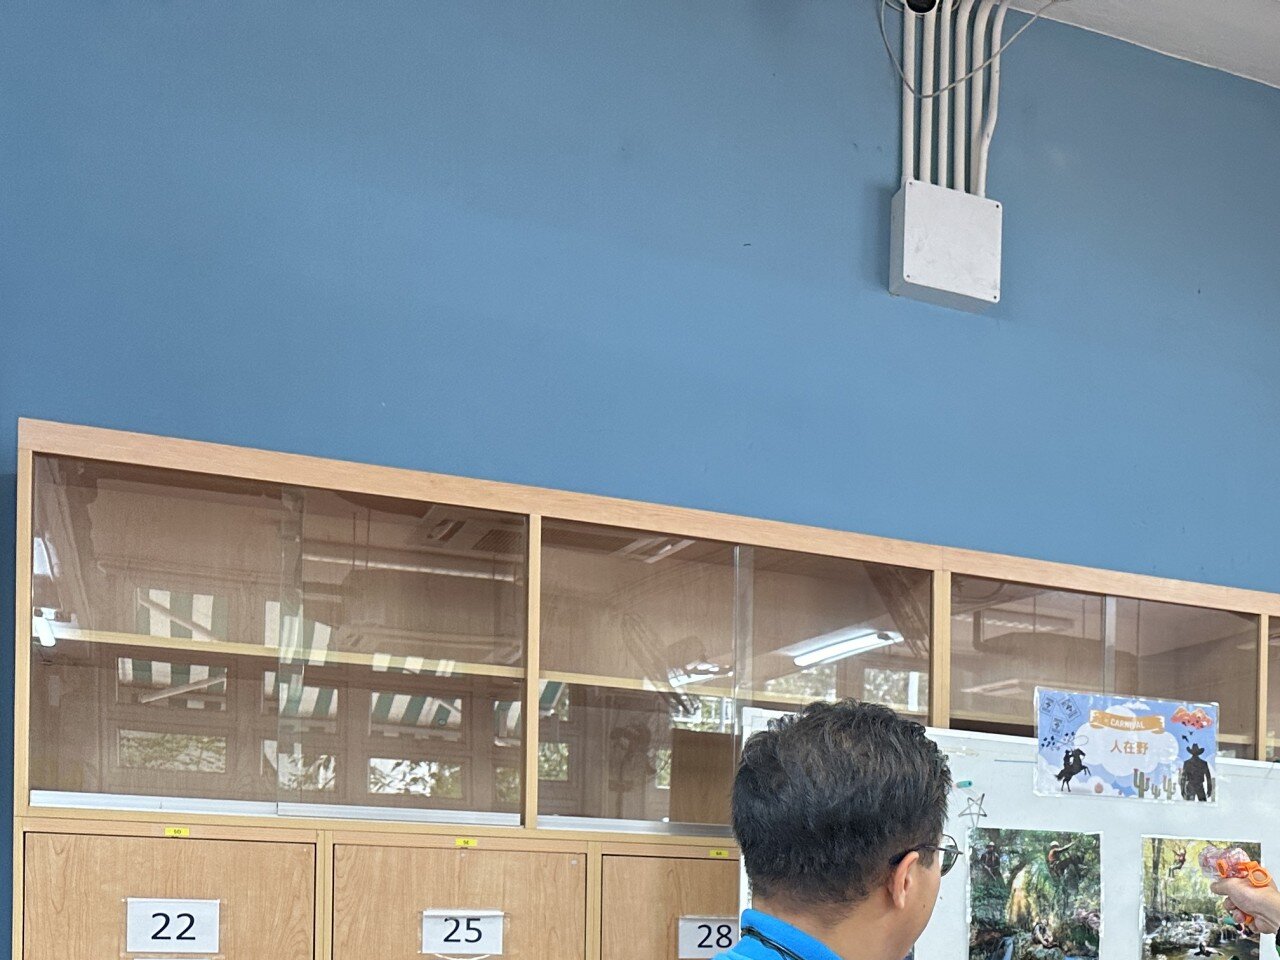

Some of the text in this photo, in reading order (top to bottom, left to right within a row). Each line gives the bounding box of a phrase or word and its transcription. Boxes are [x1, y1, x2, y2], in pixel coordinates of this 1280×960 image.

[1110, 739, 1149, 755] 人在野
[151, 912, 196, 941] 22
[443, 917, 482, 943] 25
[697, 924, 733, 949] 28
